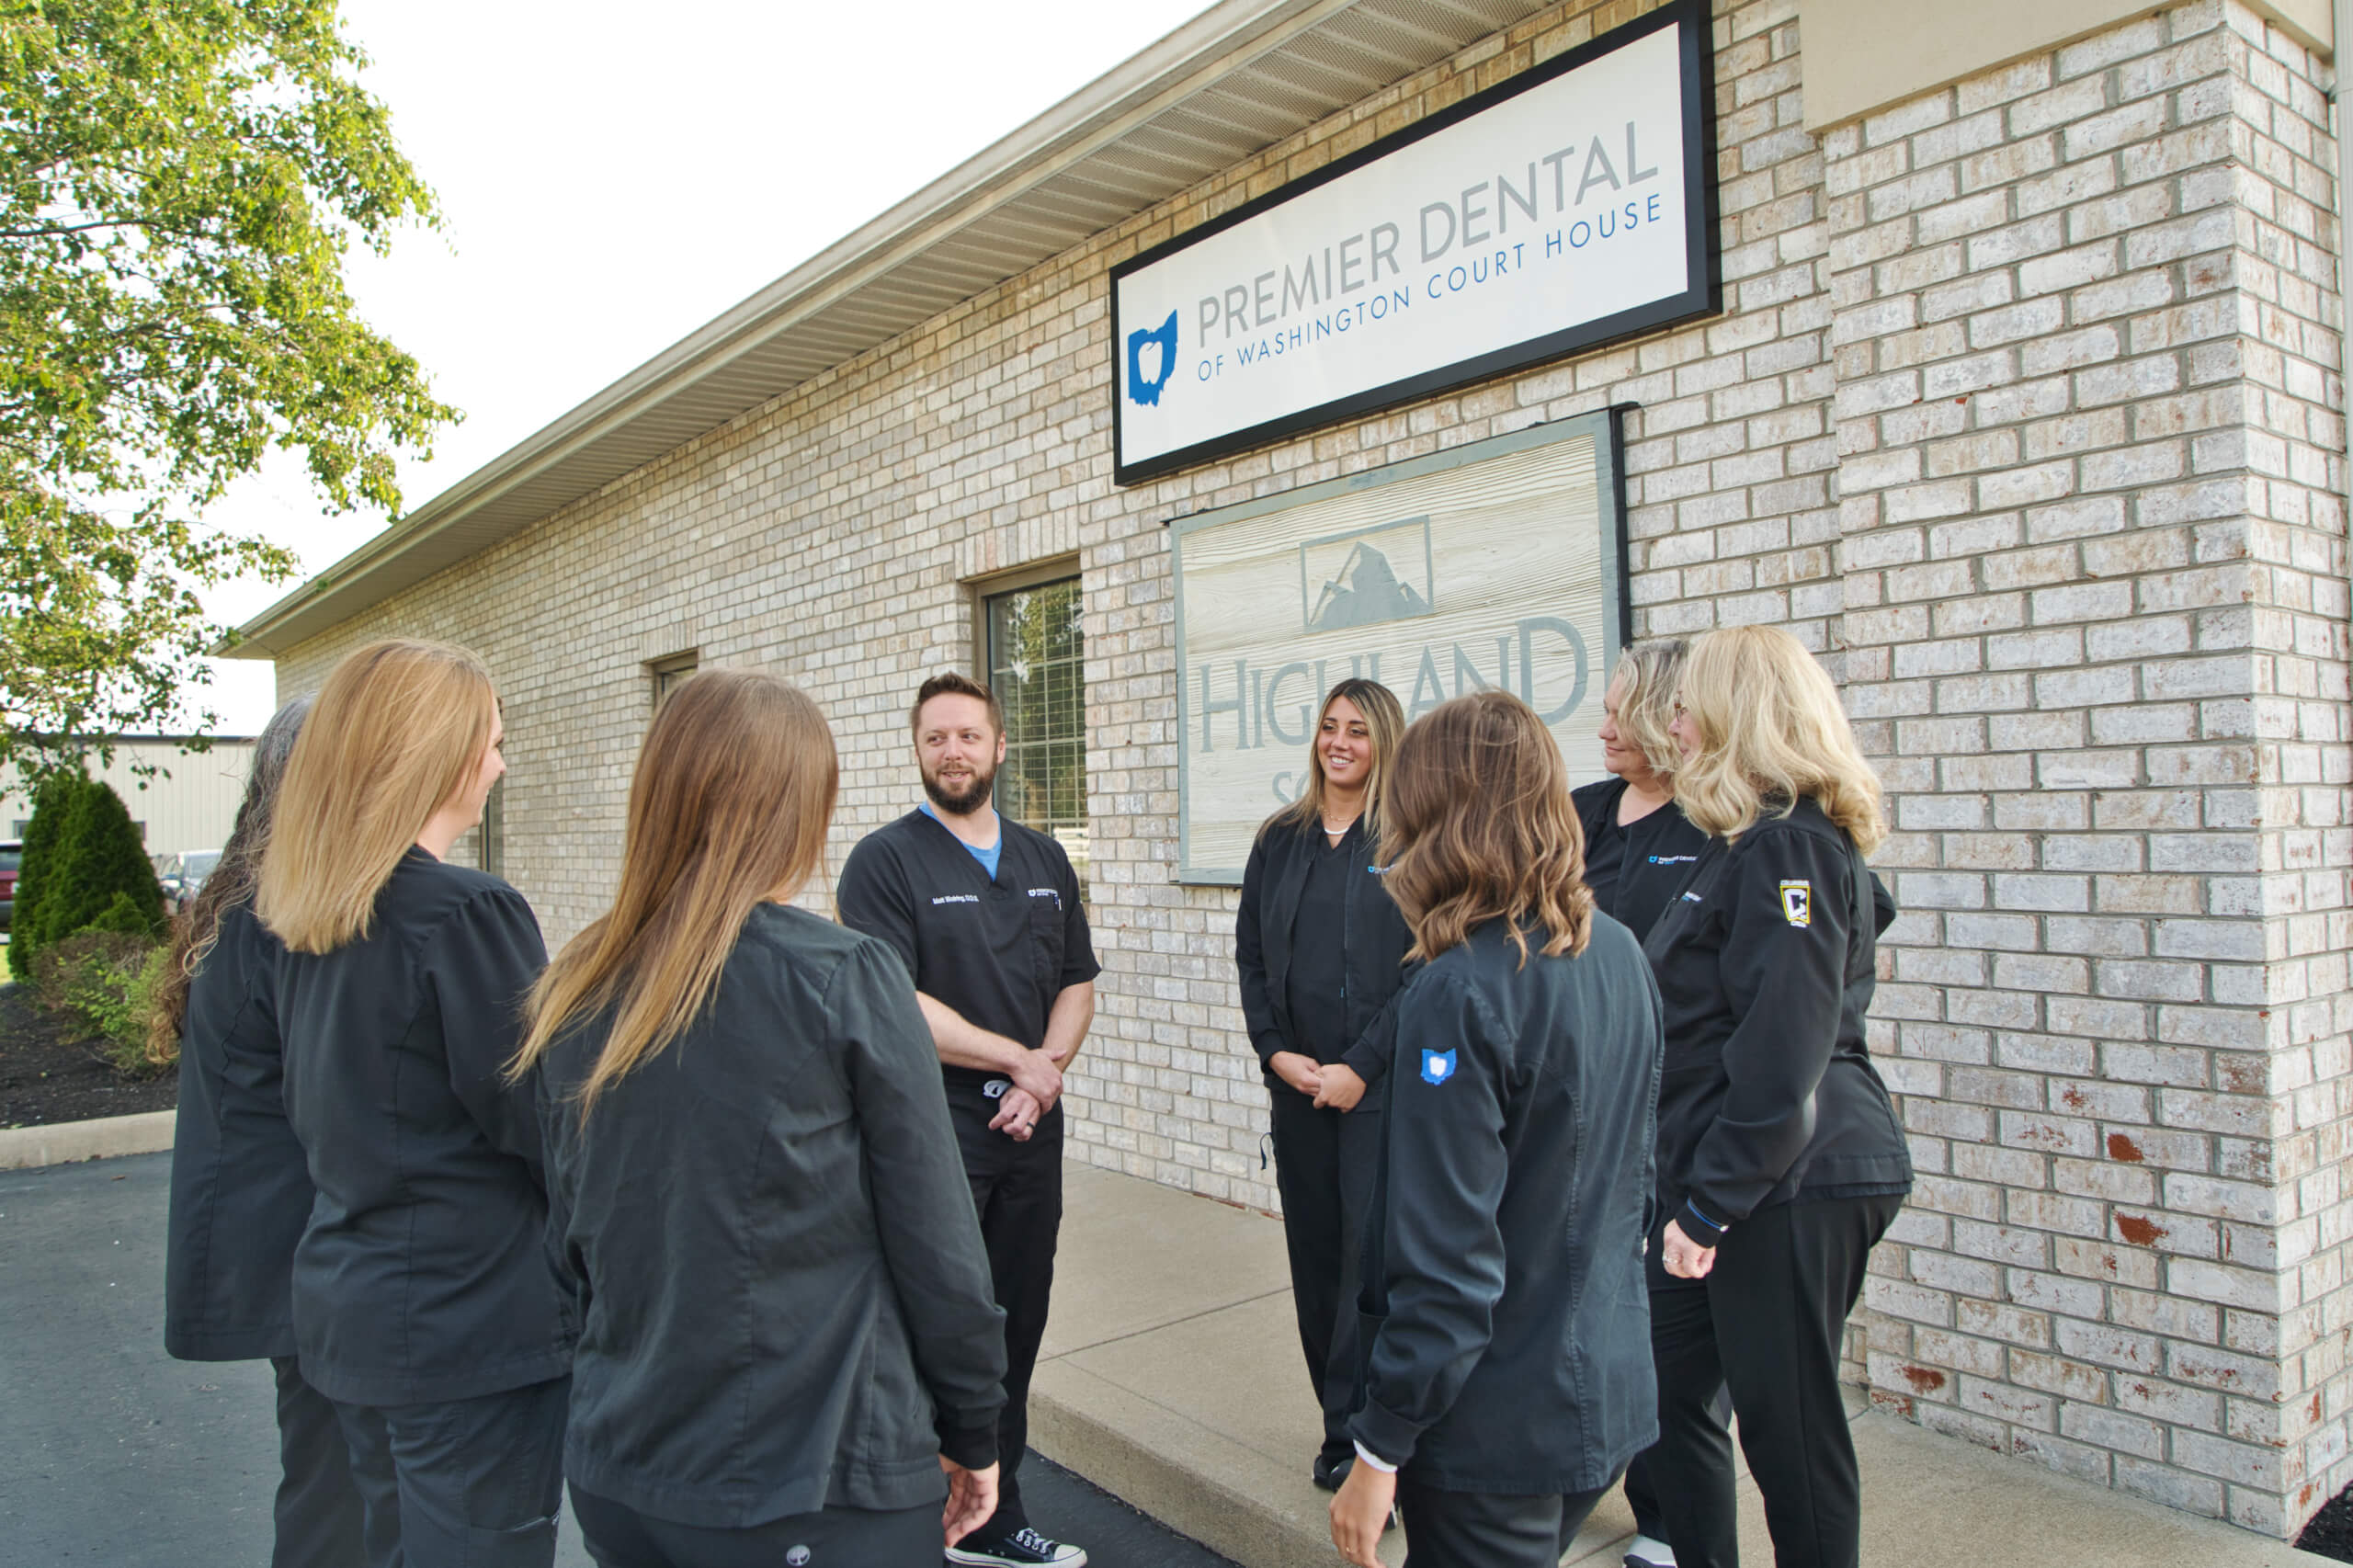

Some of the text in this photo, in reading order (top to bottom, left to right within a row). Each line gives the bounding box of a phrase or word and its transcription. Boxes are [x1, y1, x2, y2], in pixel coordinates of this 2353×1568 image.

[1198, 193, 1662, 382] OF WASHINGTON COURT HOUSE
[1199, 120, 1658, 348] PREMIER DENTAL
[1199, 617, 1588, 752] HIGAND
